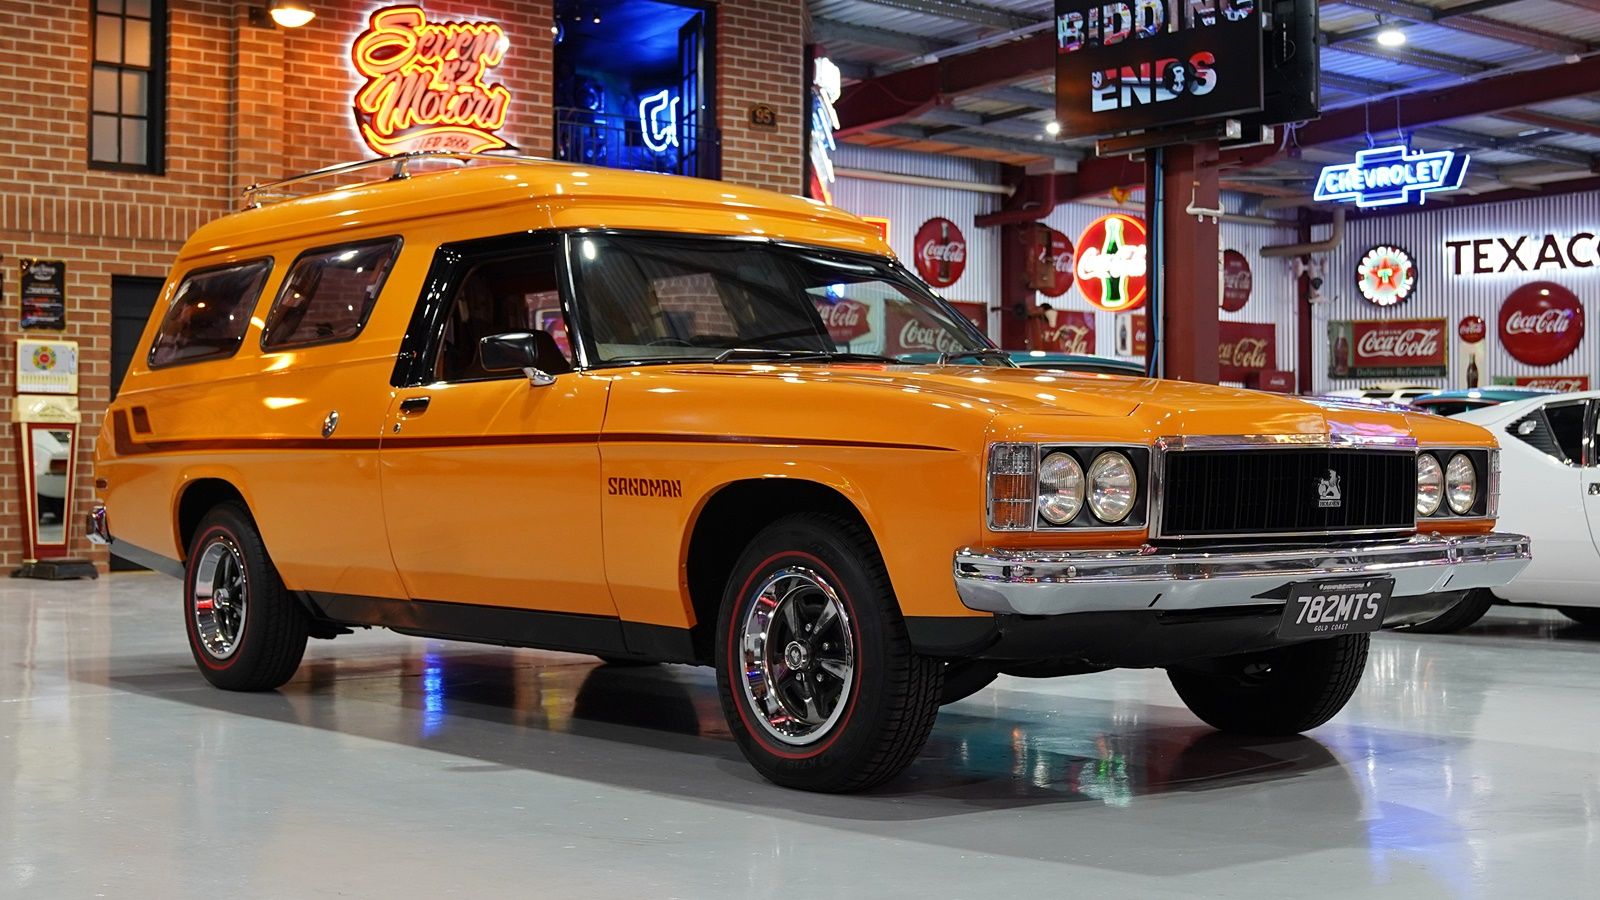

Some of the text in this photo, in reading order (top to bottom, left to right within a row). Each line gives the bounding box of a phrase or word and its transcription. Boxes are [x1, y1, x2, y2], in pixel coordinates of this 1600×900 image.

[354, 6, 506, 77] Seven
[439, 60, 480, 85] 82
[1091, 51, 1218, 113] ENDS
[359, 72, 508, 134] Motors
[1325, 159, 1444, 193] CHEVROLET
[1446, 232, 1600, 275] TEXAC
[1506, 309, 1573, 334] Coca-Cola
[1357, 328, 1440, 357] Coca-Cola
[608, 477, 682, 498] SANDMAN
[1295, 592, 1382, 625] 782MTS
[1313, 623, 1349, 632] GOLD COAST
